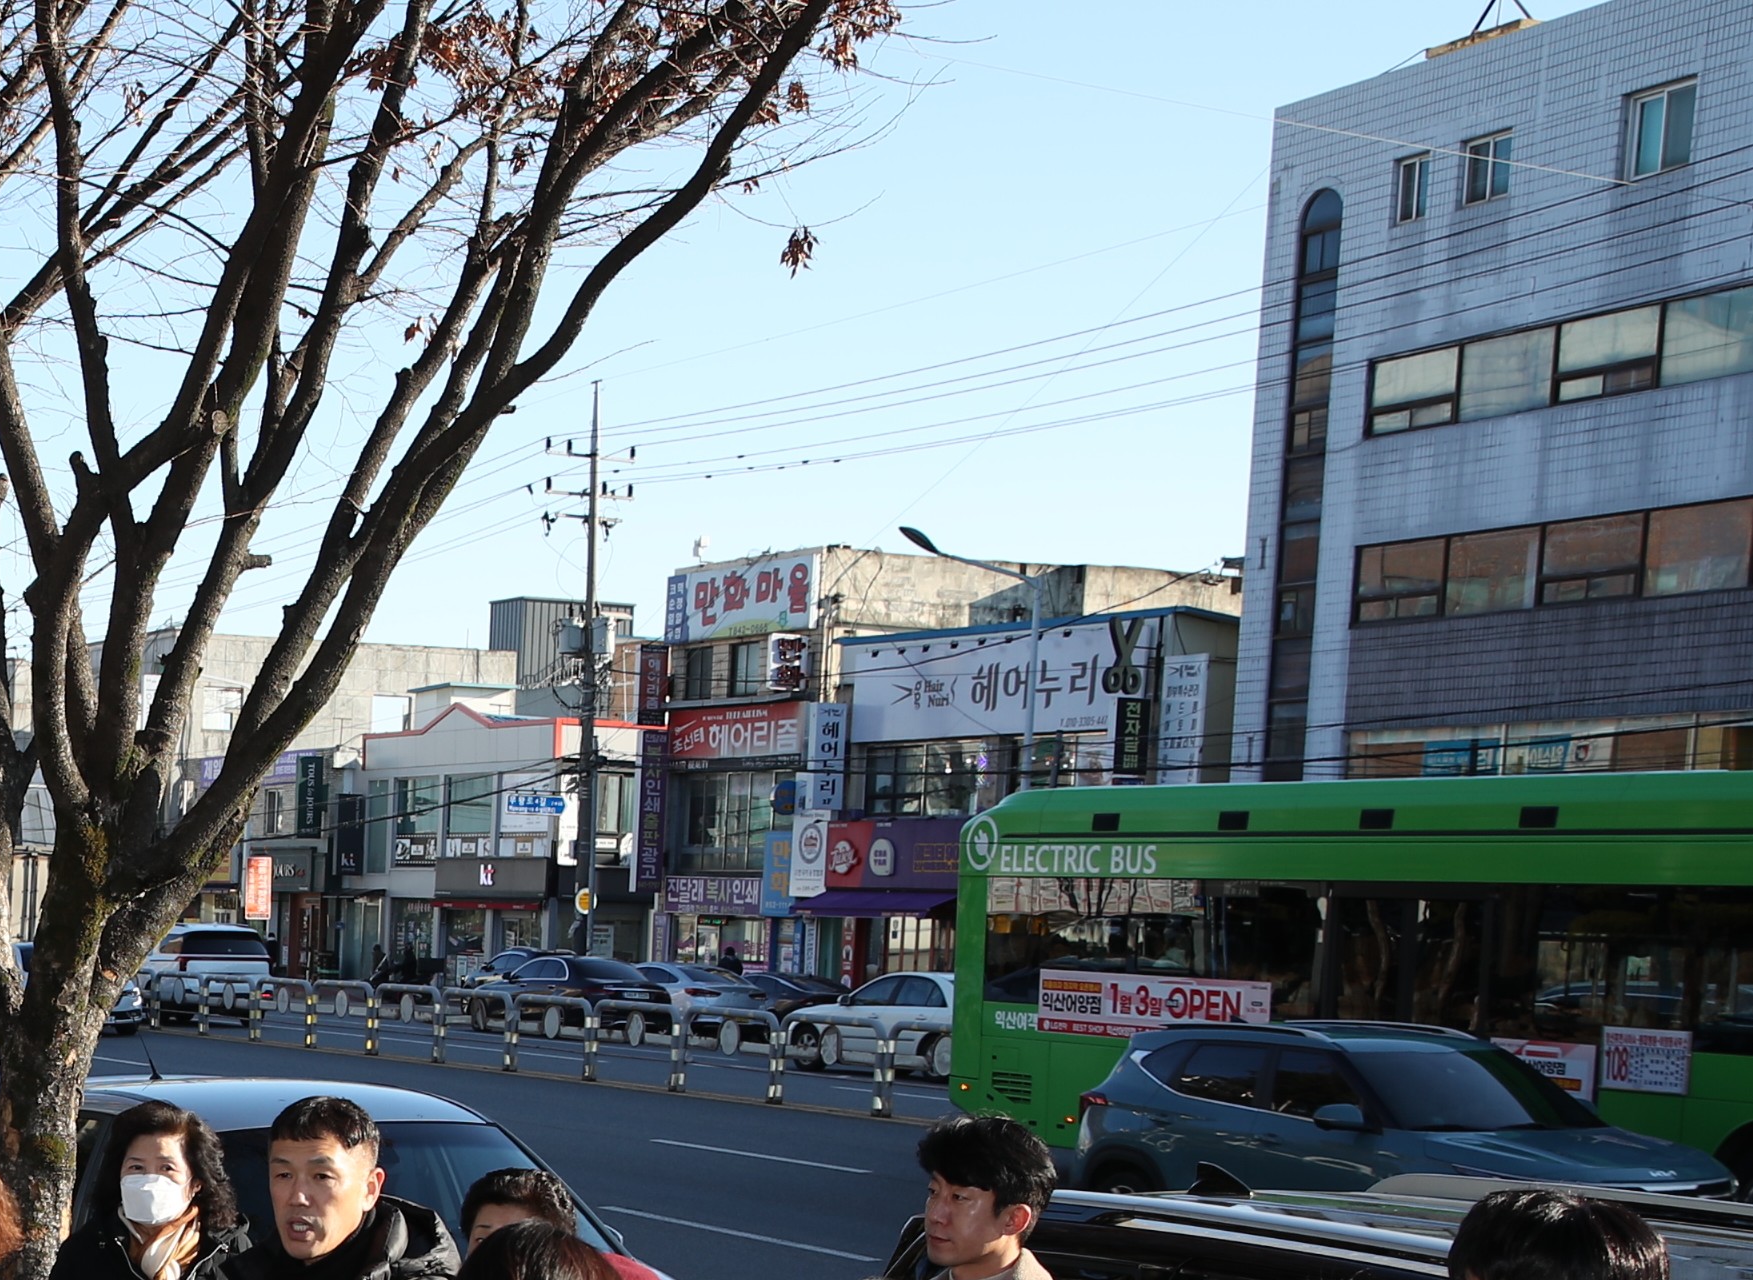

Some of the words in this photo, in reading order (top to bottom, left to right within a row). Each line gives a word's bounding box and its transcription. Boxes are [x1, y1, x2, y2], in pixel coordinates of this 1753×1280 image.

[924, 680, 945, 693] Hair
[970, 653, 1099, 712] 헤어누리
[927, 694, 949, 707] Nuri
[708, 718, 798, 758] 헤어리즘
[1122, 701, 1142, 769] 전자담배
[307, 762, 316, 787] TOUS
[306, 795, 316, 826] JOURS
[479, 863, 495, 886] kt
[1000, 845, 1100, 873] ELECTRIC
[1110, 845, 1157, 874] BUS
[1042, 991, 1102, 1015] 익산어양점
[1167, 987, 1242, 1021] OPEN
[994, 1009, 1038, 1031] 익산여객
[1605, 1046, 1629, 1081] 108
